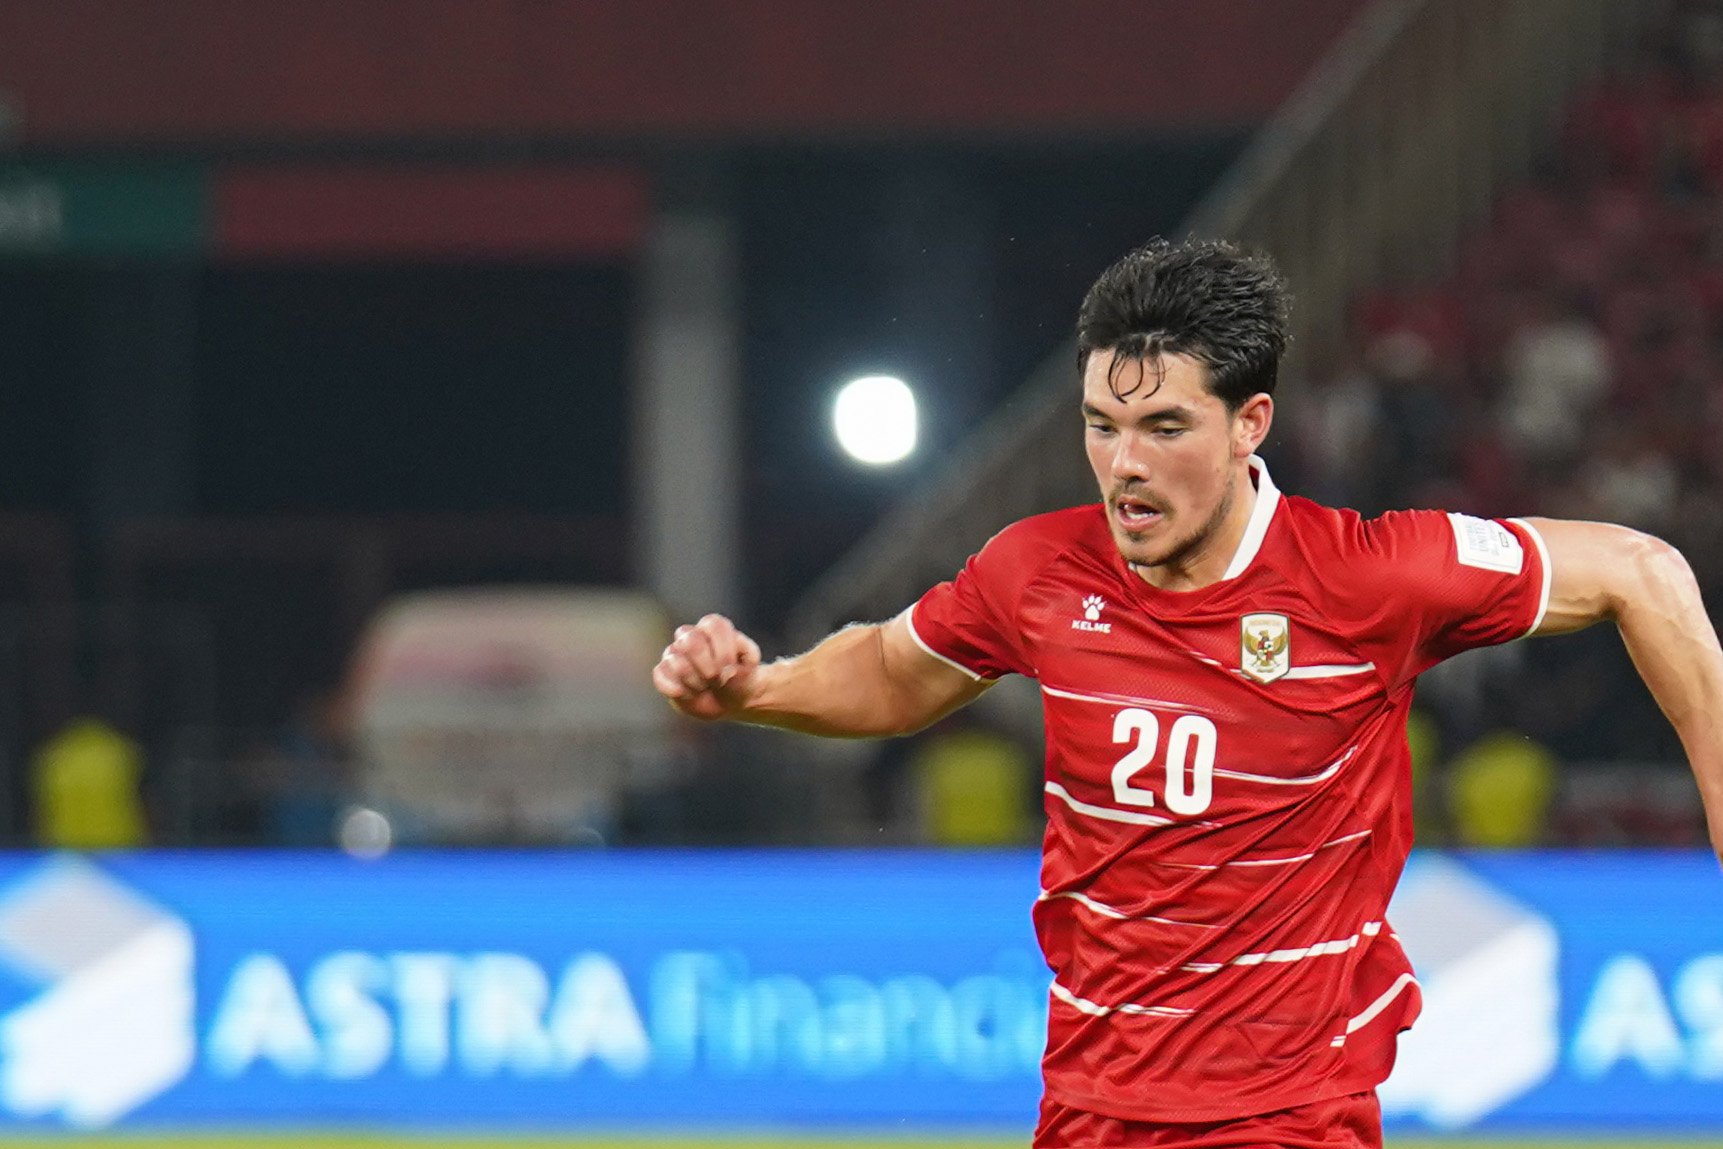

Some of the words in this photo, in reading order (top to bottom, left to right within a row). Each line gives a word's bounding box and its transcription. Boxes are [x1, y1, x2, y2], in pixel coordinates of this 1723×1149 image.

[1071, 619, 1112, 634] KELME
[1111, 707, 1218, 815] 20
[210, 951, 650, 1079] ASTRA
[650, 948, 1046, 1080] Financi
